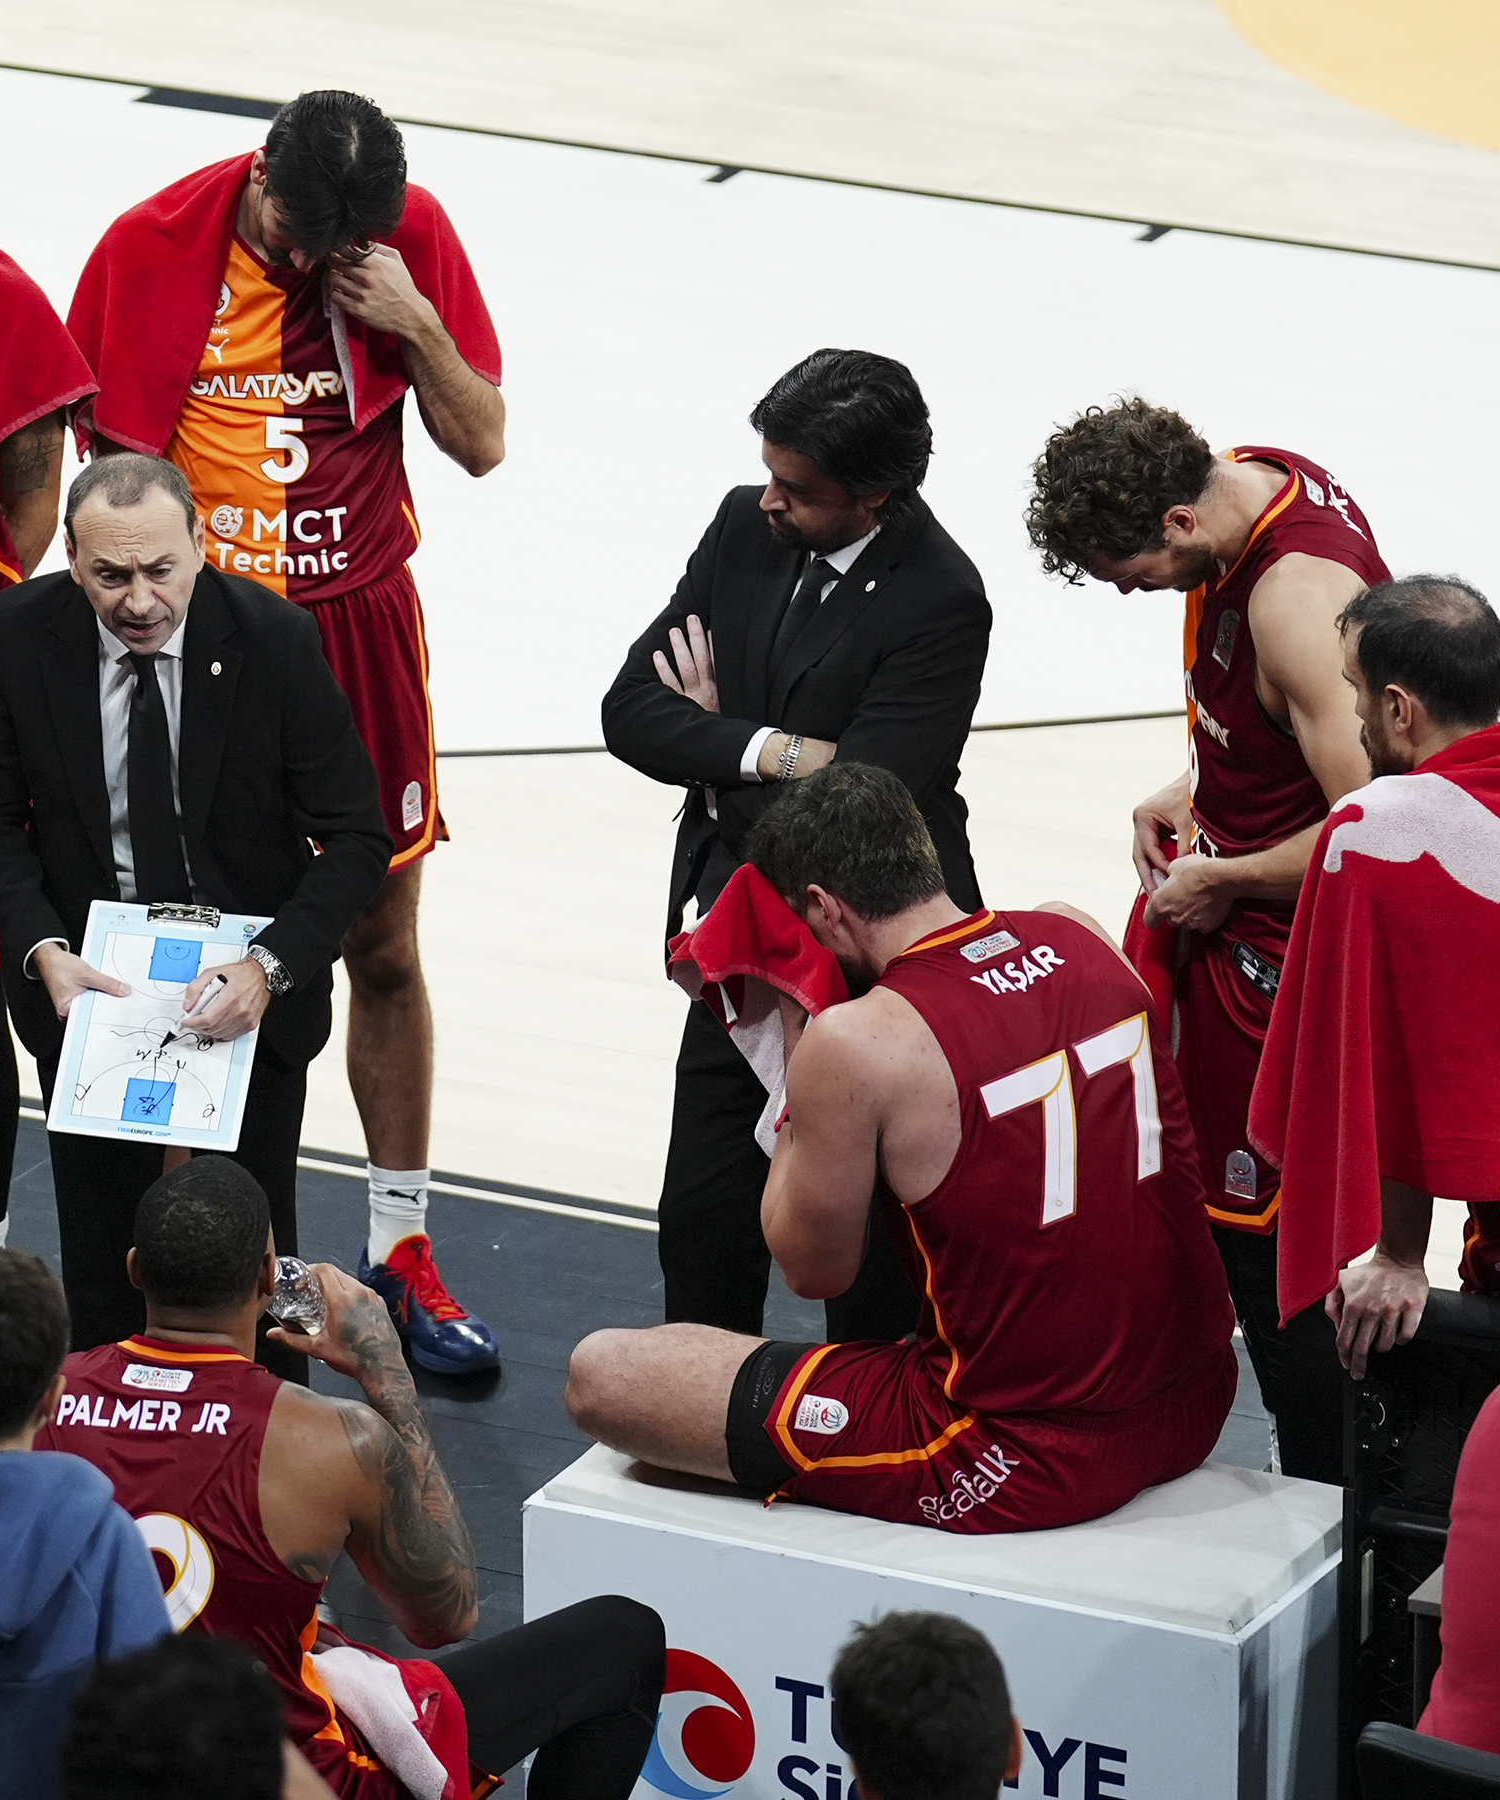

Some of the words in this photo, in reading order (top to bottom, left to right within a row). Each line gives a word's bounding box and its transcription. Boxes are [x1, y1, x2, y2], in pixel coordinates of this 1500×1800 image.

[190, 370, 344, 406] GALATASAR
[259, 415, 310, 485] 5
[252, 506, 348, 543] MCT
[214, 543, 349, 576] Technic
[969, 943, 1066, 996] YAŞAR
[978, 1010, 1163, 1228] 77
[56, 1393, 182, 1431] PALMER
[192, 1403, 232, 1435] JR
